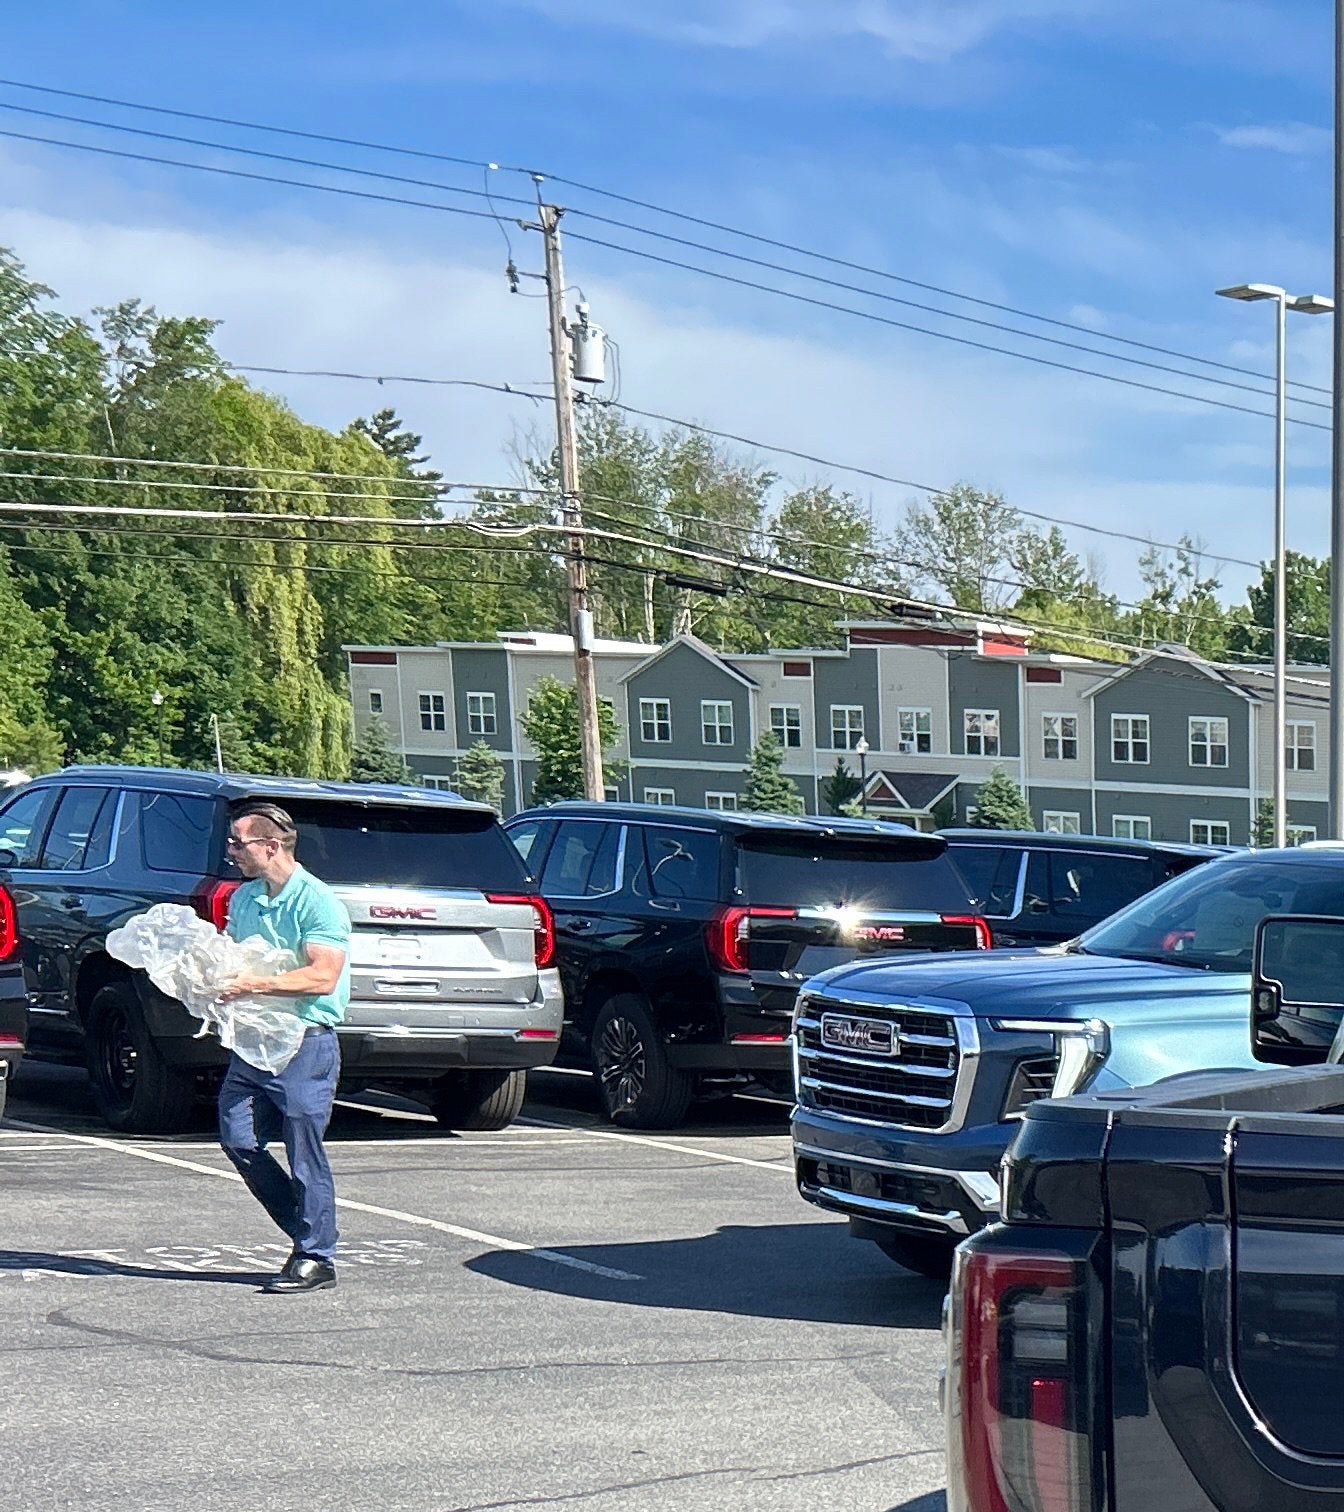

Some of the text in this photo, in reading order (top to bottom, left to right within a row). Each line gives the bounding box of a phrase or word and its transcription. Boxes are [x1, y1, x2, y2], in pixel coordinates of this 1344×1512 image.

[369, 905, 437, 920] GMC
[851, 926, 904, 940] GMC
[824, 1018, 891, 1049] GMC
